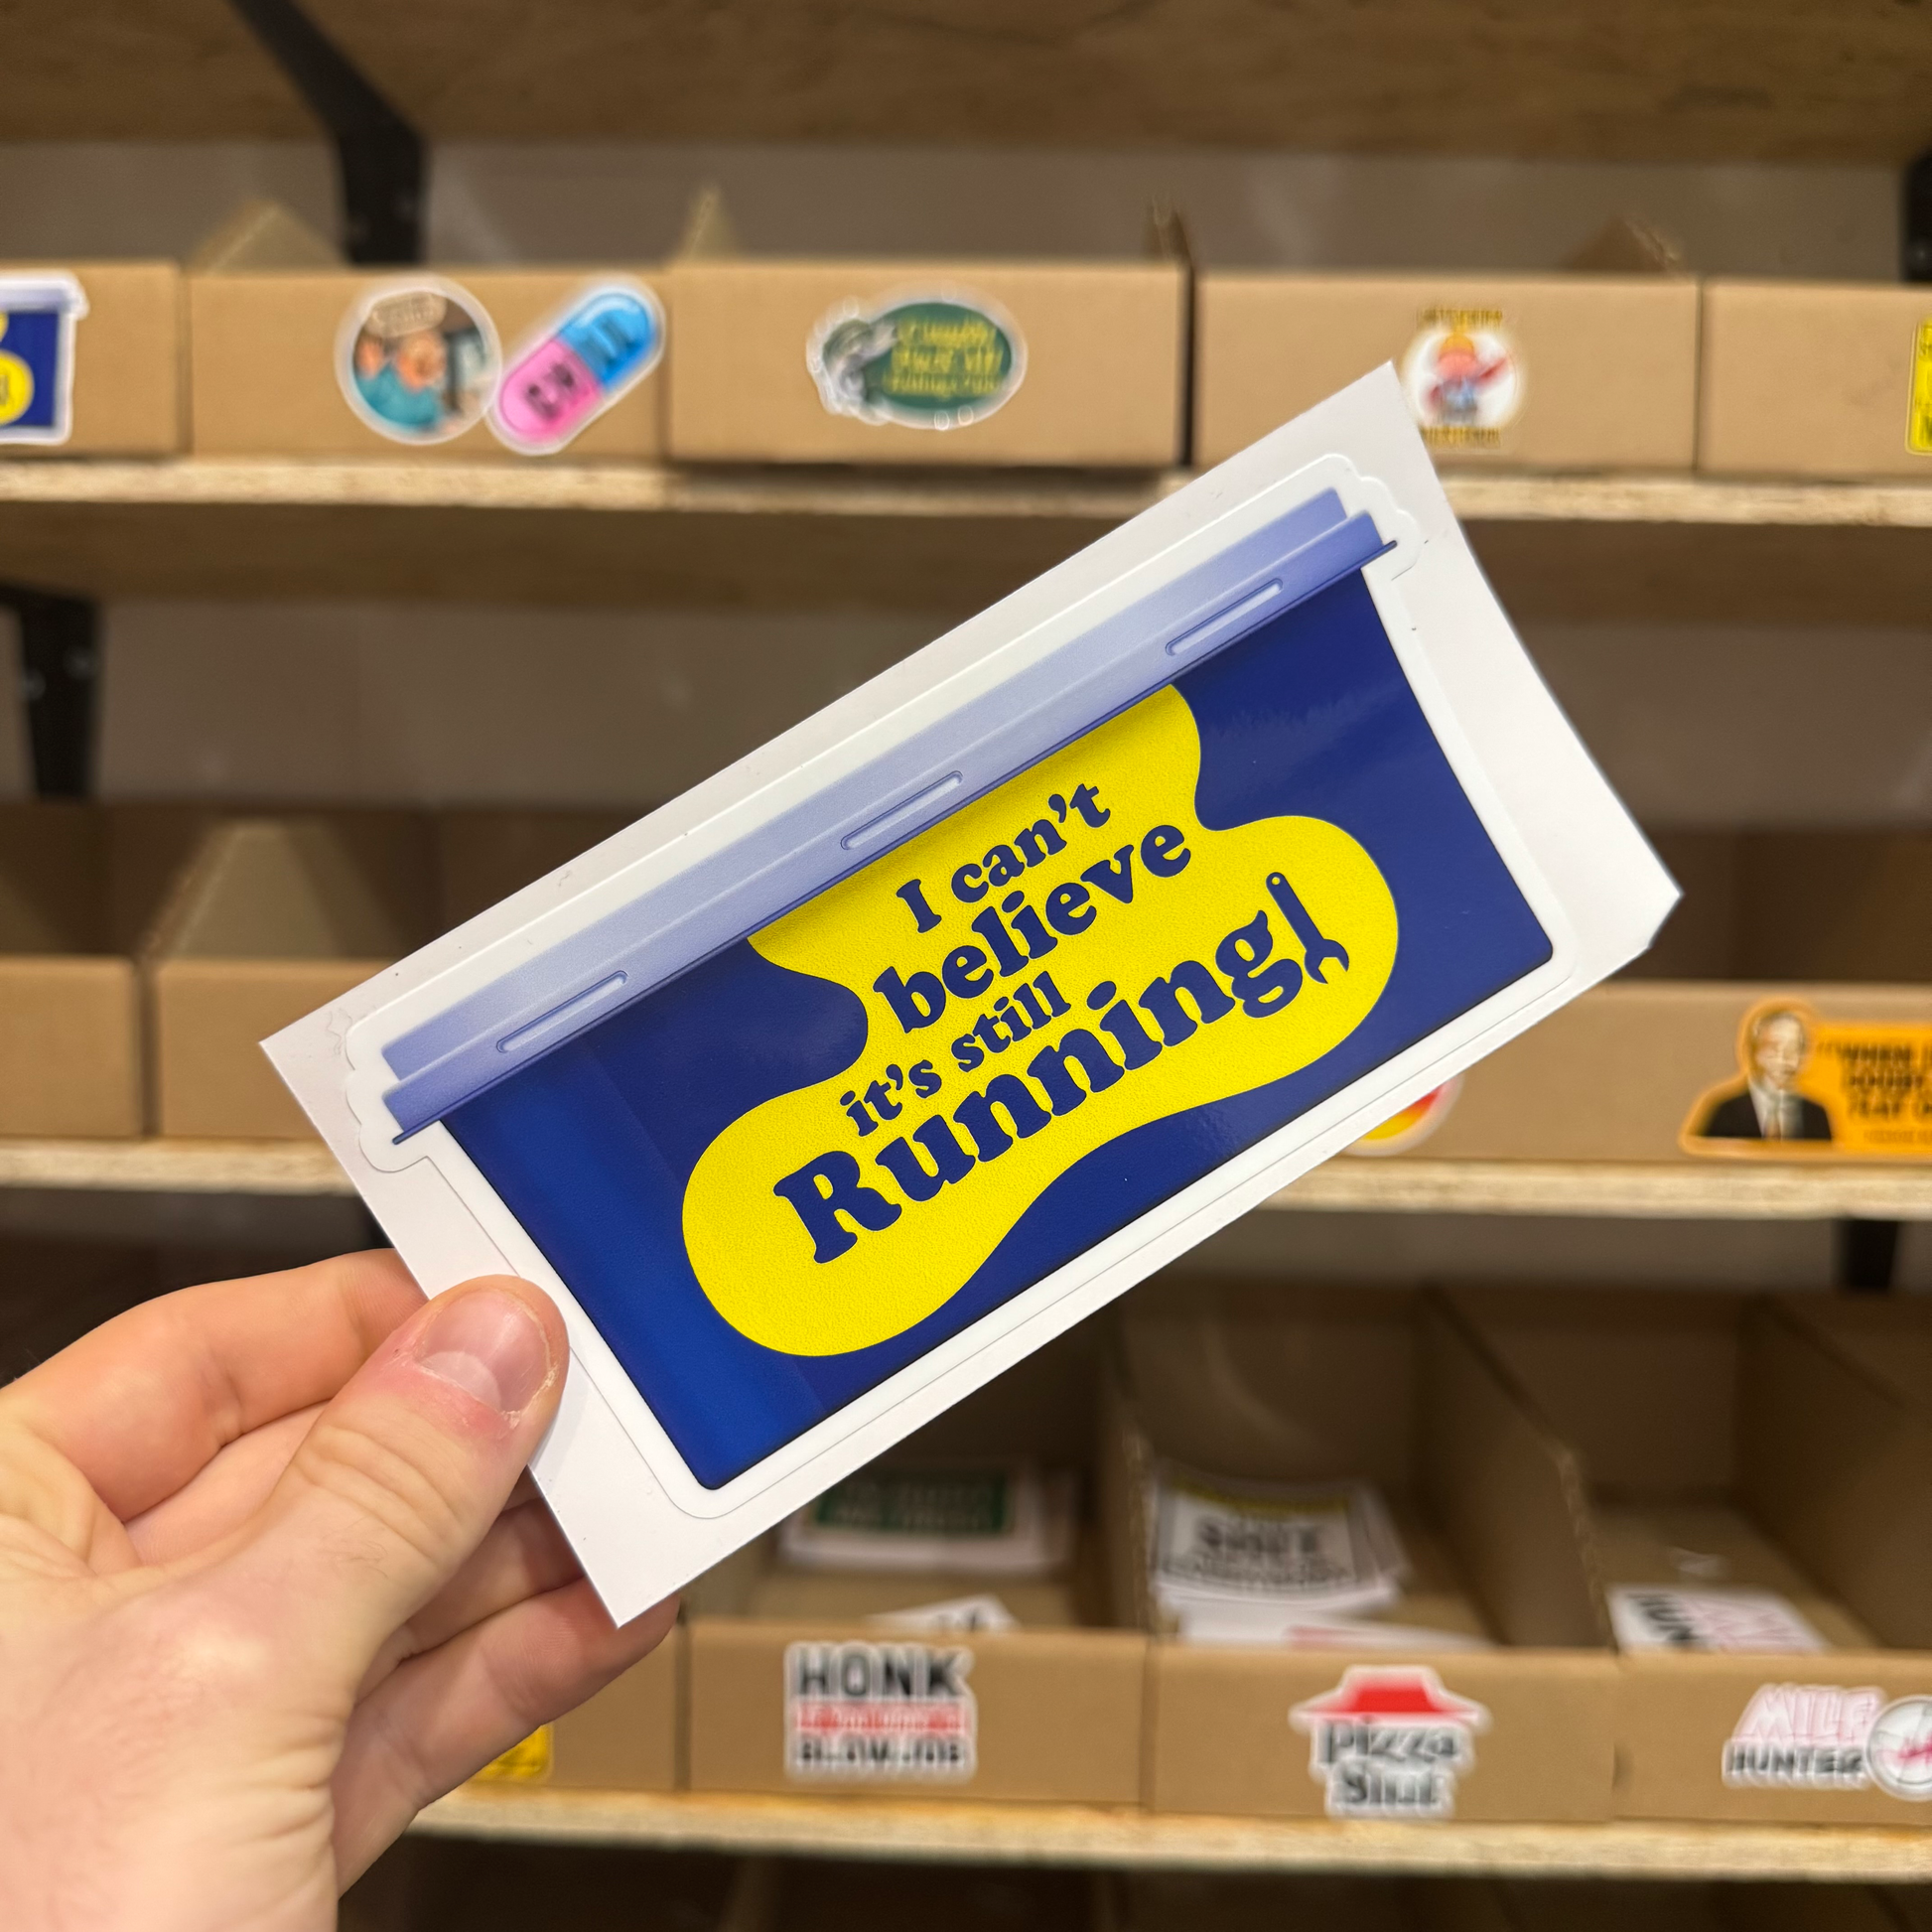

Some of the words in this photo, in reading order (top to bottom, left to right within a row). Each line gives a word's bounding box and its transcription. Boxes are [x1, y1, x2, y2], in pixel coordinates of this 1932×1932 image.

[873, 825, 1191, 1033] believe
[897, 880, 941, 933] I
[951, 783, 1111, 903] can't
[840, 1060, 941, 1137] it's
[951, 970, 1071, 1072] still
[798, 1647, 964, 1697] HONK
